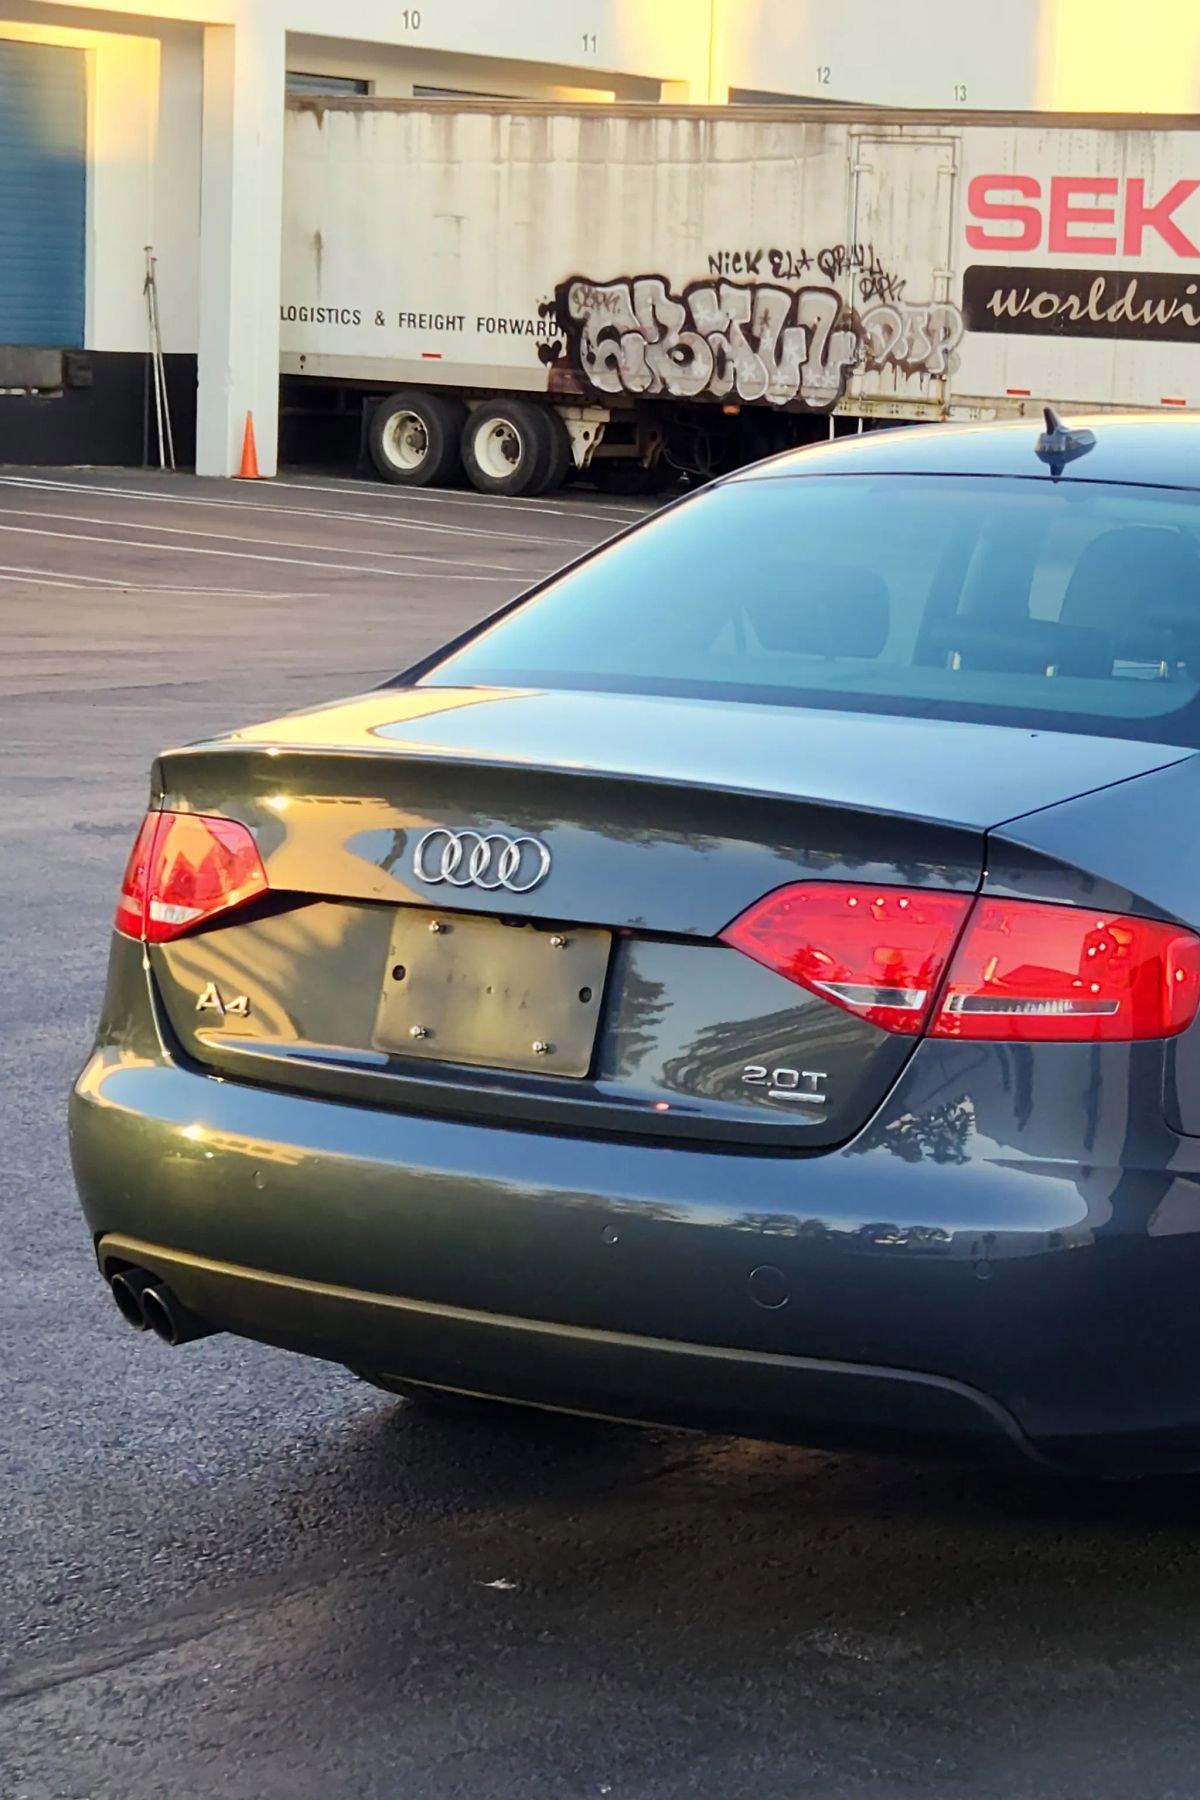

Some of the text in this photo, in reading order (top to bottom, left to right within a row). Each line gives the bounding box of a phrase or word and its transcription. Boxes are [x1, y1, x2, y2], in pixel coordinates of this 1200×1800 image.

[402, 10, 421, 30] 10
[582, 33, 597, 53] 11
[816, 65, 831, 84] 12
[953, 84, 968, 102] 13
[280, 305, 566, 338] LOGISTICS & FREIGHT FORWARD
[195, 981, 249, 1016] A4
[741, 1065, 828, 1091] 2.0T
